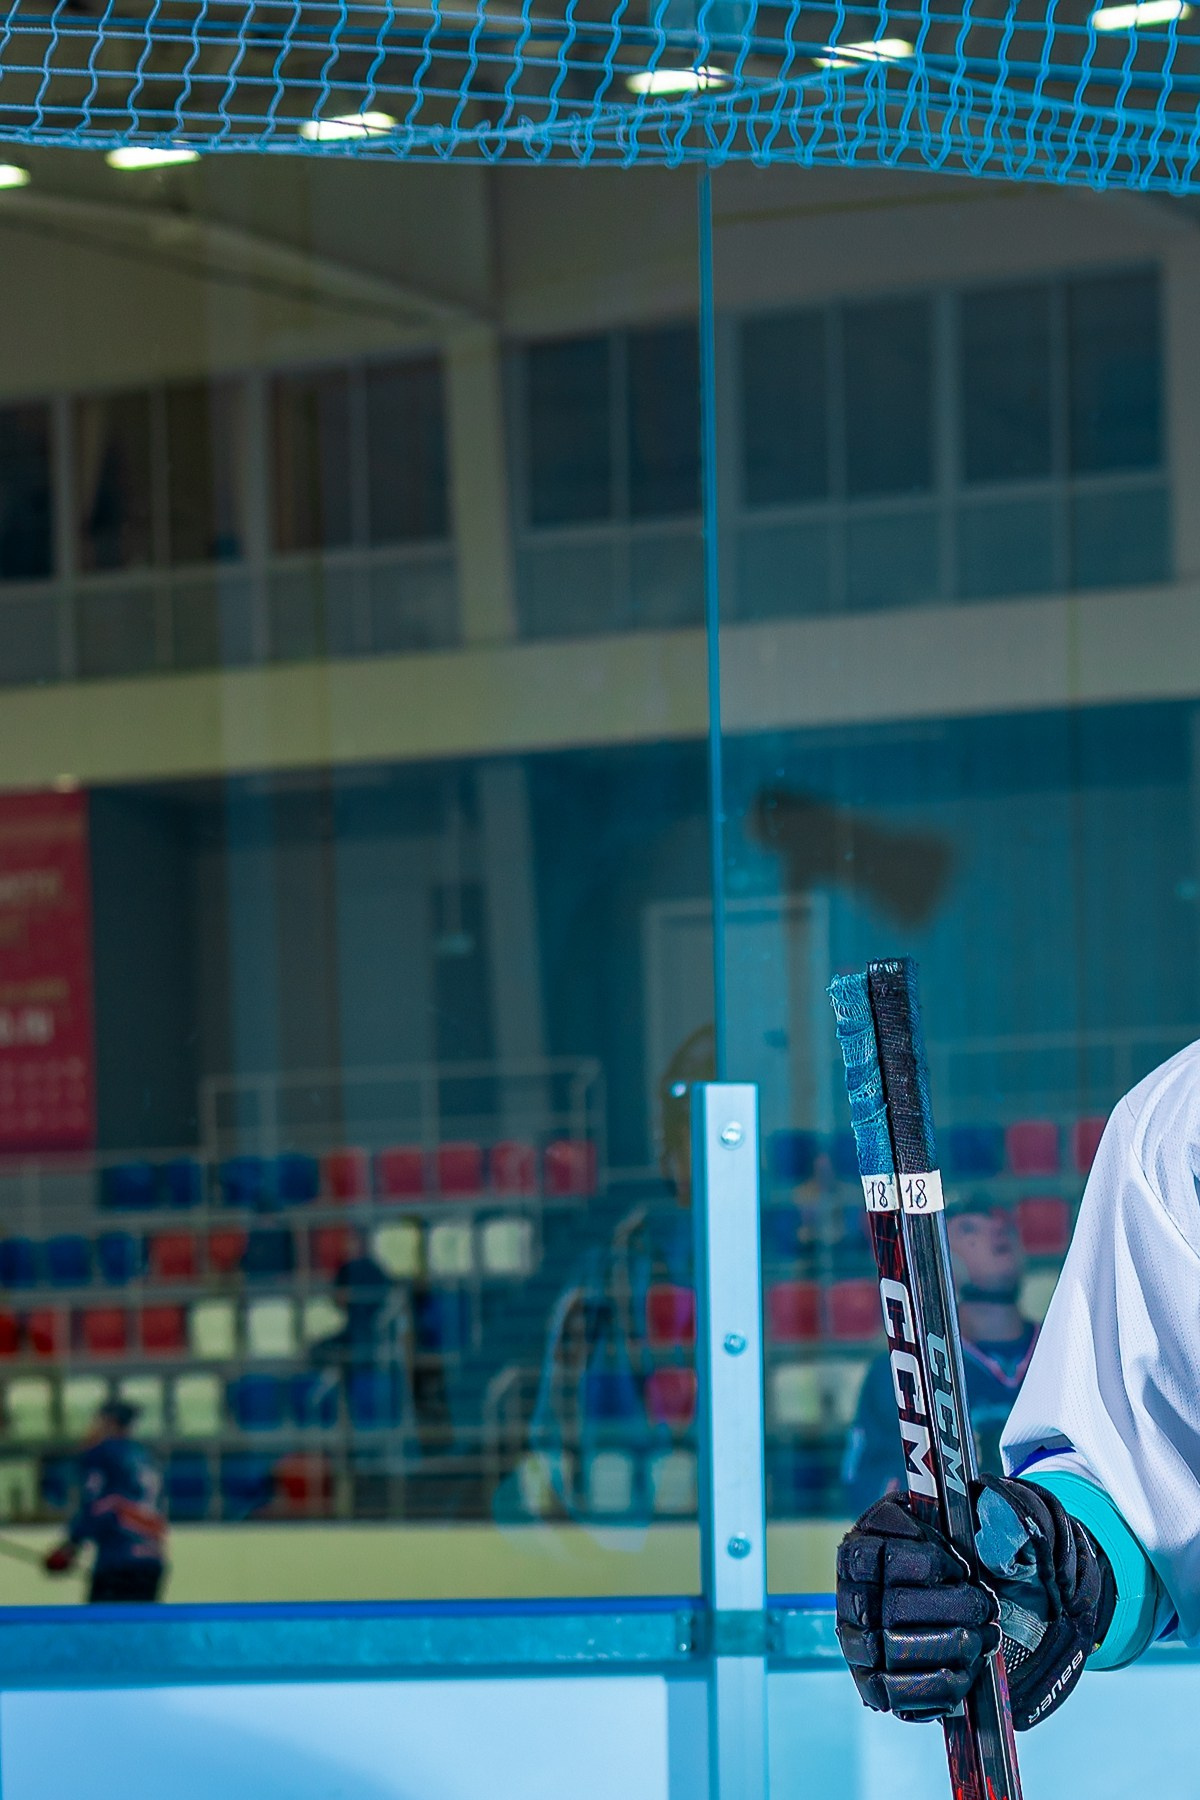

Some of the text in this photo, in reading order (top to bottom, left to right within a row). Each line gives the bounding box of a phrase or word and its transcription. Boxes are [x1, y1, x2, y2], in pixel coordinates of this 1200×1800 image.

[867, 1180, 889, 1209] 18
[905, 1179, 928, 1209] 18
[880, 1278, 939, 1499] CCM
[926, 1332, 968, 1498] CCM
[1027, 1648, 1084, 1725] BAUER
